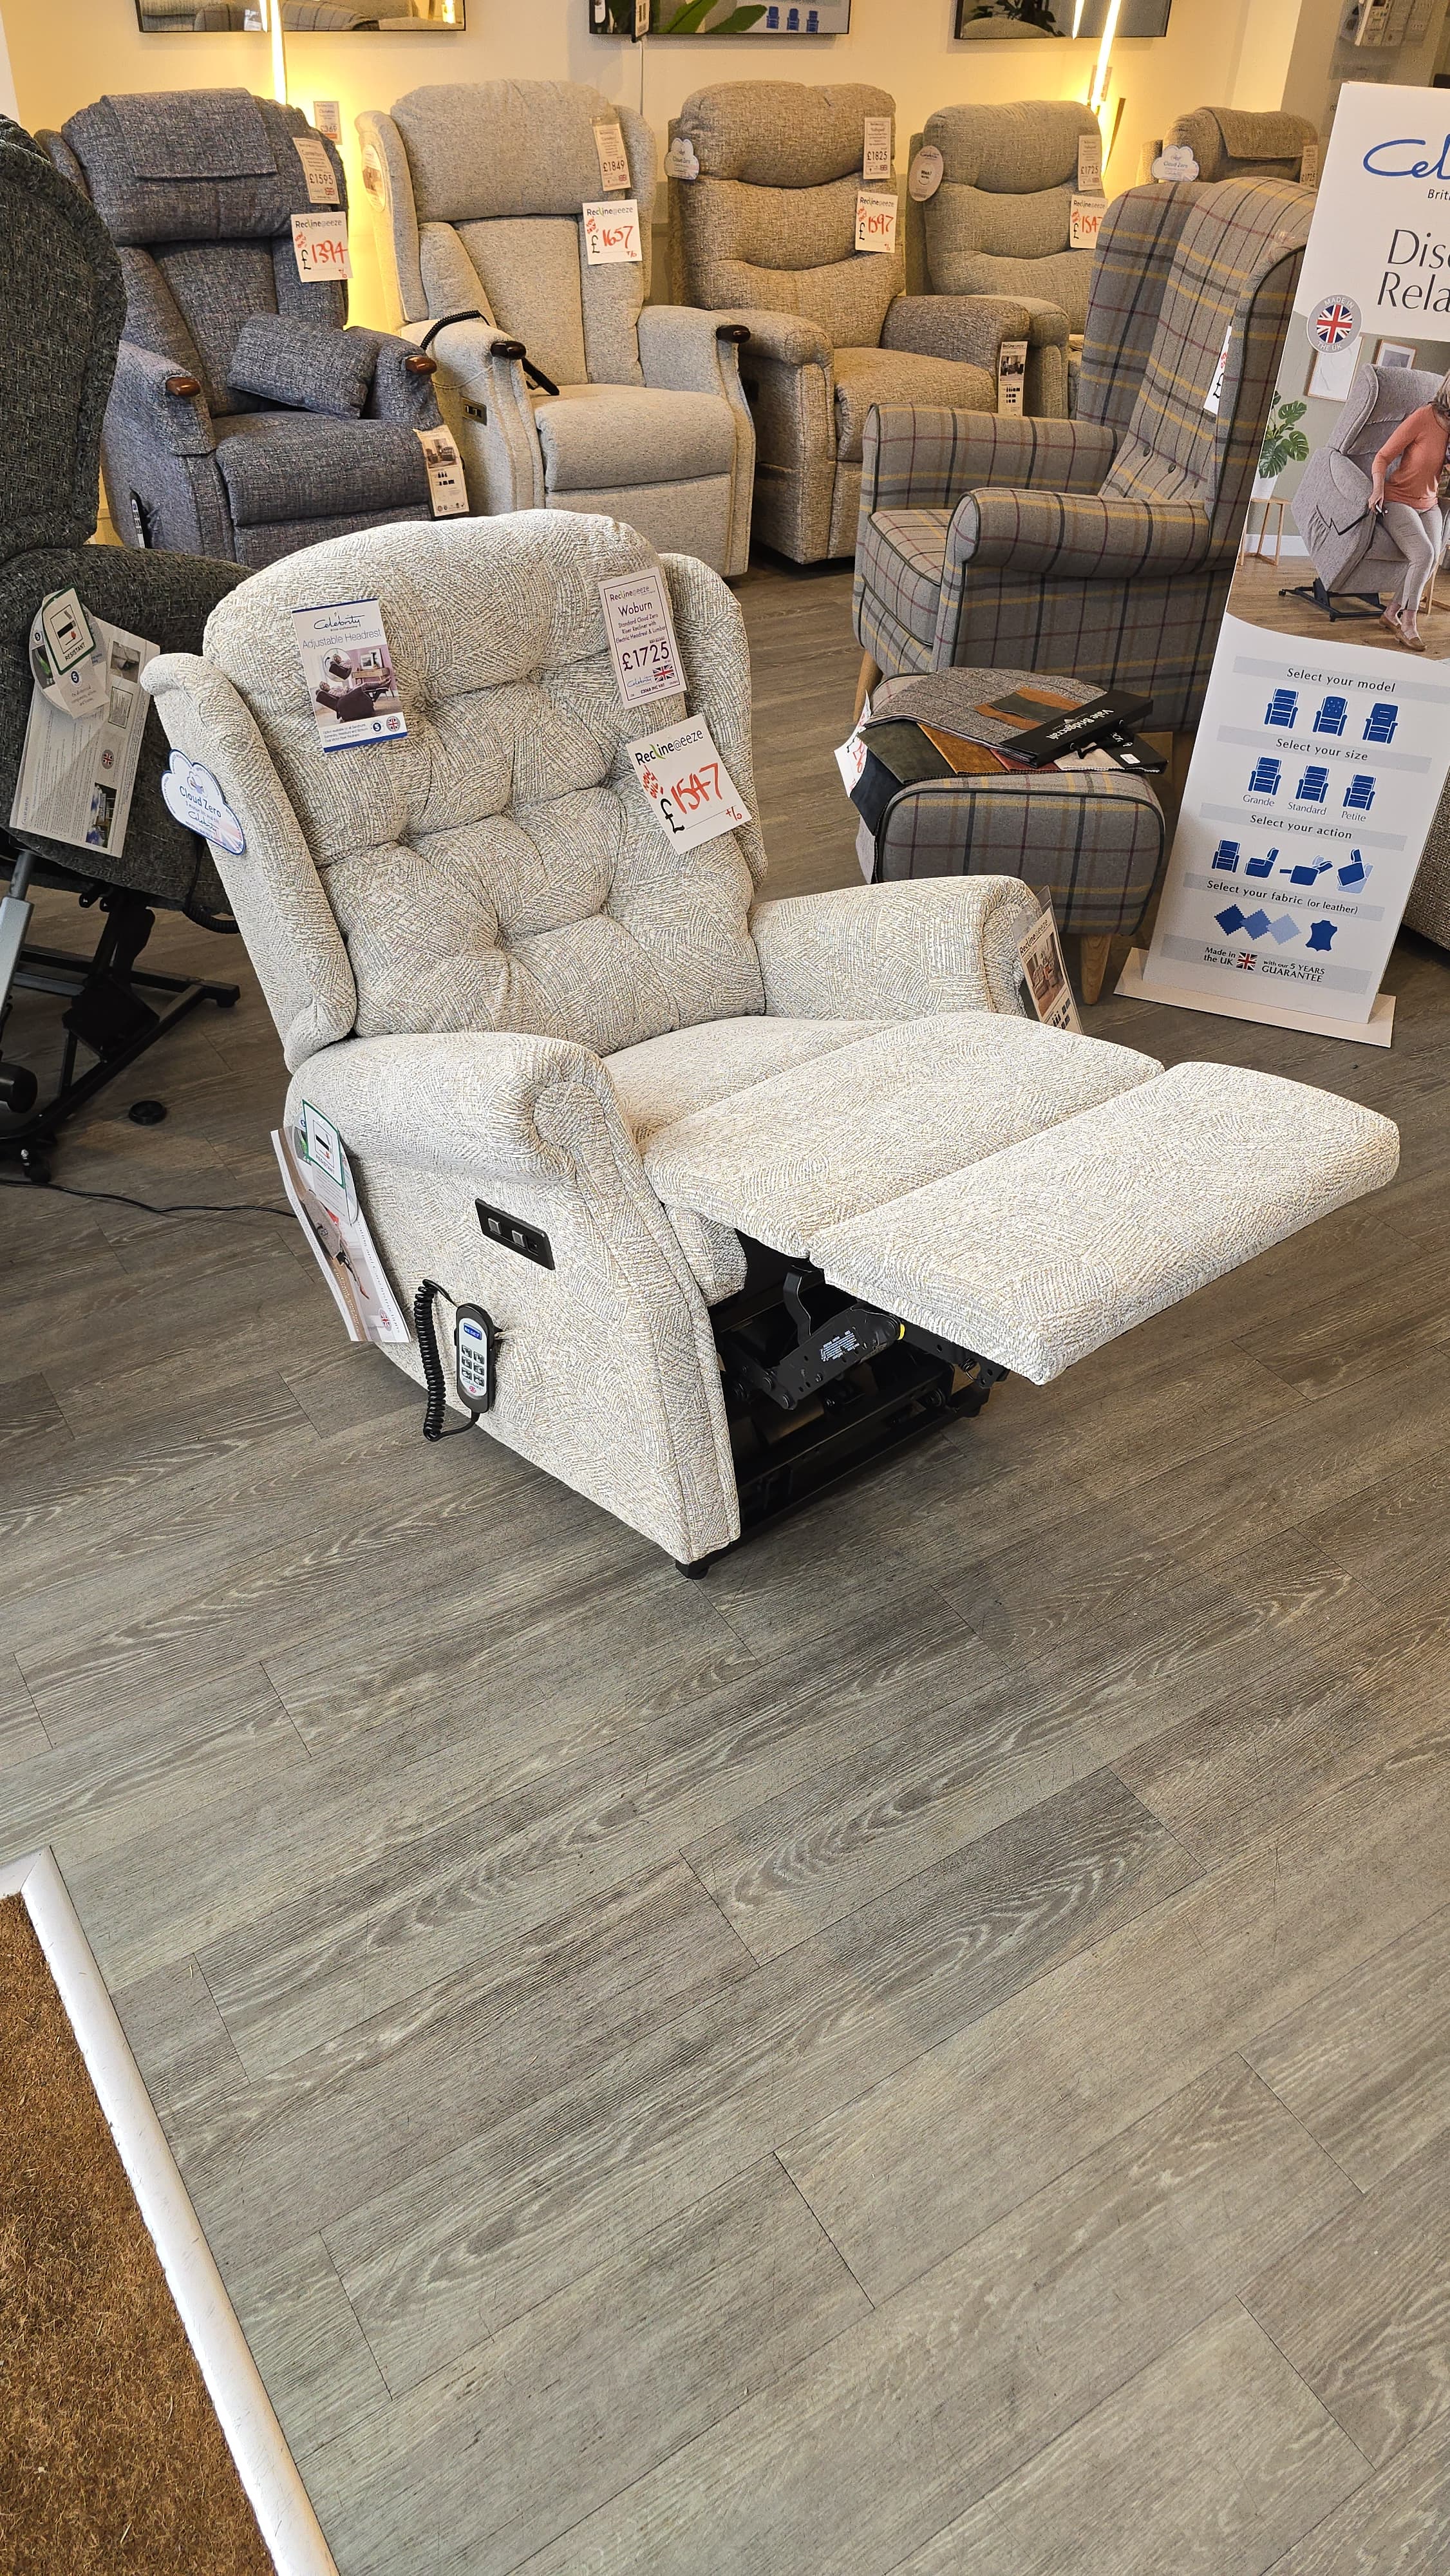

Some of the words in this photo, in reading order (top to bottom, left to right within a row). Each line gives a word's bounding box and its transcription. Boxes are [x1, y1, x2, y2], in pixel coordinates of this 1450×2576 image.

[867, 151, 888, 160] £1825
[603, 160, 625, 173] £1849
[309, 173, 334, 185] £1595
[1388, 229, 1450, 269] Dis
[1324, 297, 1346, 306] MADE
[1347, 300, 1355, 309] IN
[1317, 341, 1330, 351] THE
[1332, 343, 1342, 351] UK
[618, 601, 653, 617] Woburn
[314, 614, 365, 630] Celebrity
[618, 618, 636, 629] Standard
[637, 615, 649, 623] Cloud
[303, 634, 343, 650] Adjustable
[344, 628, 382, 643] Headrest
[616, 636, 630, 644] Electric
[630, 630, 648, 639] Headrest
[65, 642, 86, 661] RESISTANT
[622, 641, 670, 671] £1725
[1287, 668, 1323, 682] Select
[1326, 675, 1353, 687] your
[1357, 681, 1396, 693] model
[1089, 709, 1115, 720] Vale
[1045, 716, 1095, 740] Bridgecraft
[1276, 738, 1311, 752] Select
[1315, 745, 1341, 757] your
[1345, 750, 1369, 761] size
[180, 785, 202, 806] Cloud
[203, 799, 221, 818] Zero
[1243, 794, 1276, 807] Grande
[1287, 801, 1327, 816] Standard
[1341, 810, 1366, 822] Petite
[1250, 815, 1283, 828] Select
[1287, 821, 1313, 833] your
[1317, 826, 1352, 840] action
[1207, 880, 1239, 894] Select
[1243, 887, 1268, 900] your
[1271, 891, 1303, 905] fabric
[1306, 898, 1321, 908] (or
[1323, 901, 1359, 915] leather)
[1205, 947, 1227, 957] Made
[1203, 954, 1218, 963] the
[1219, 957, 1234, 966] UK
[1261, 965, 1323, 983] GUARANTEE
[1298, 964, 1325, 975] YEARS
